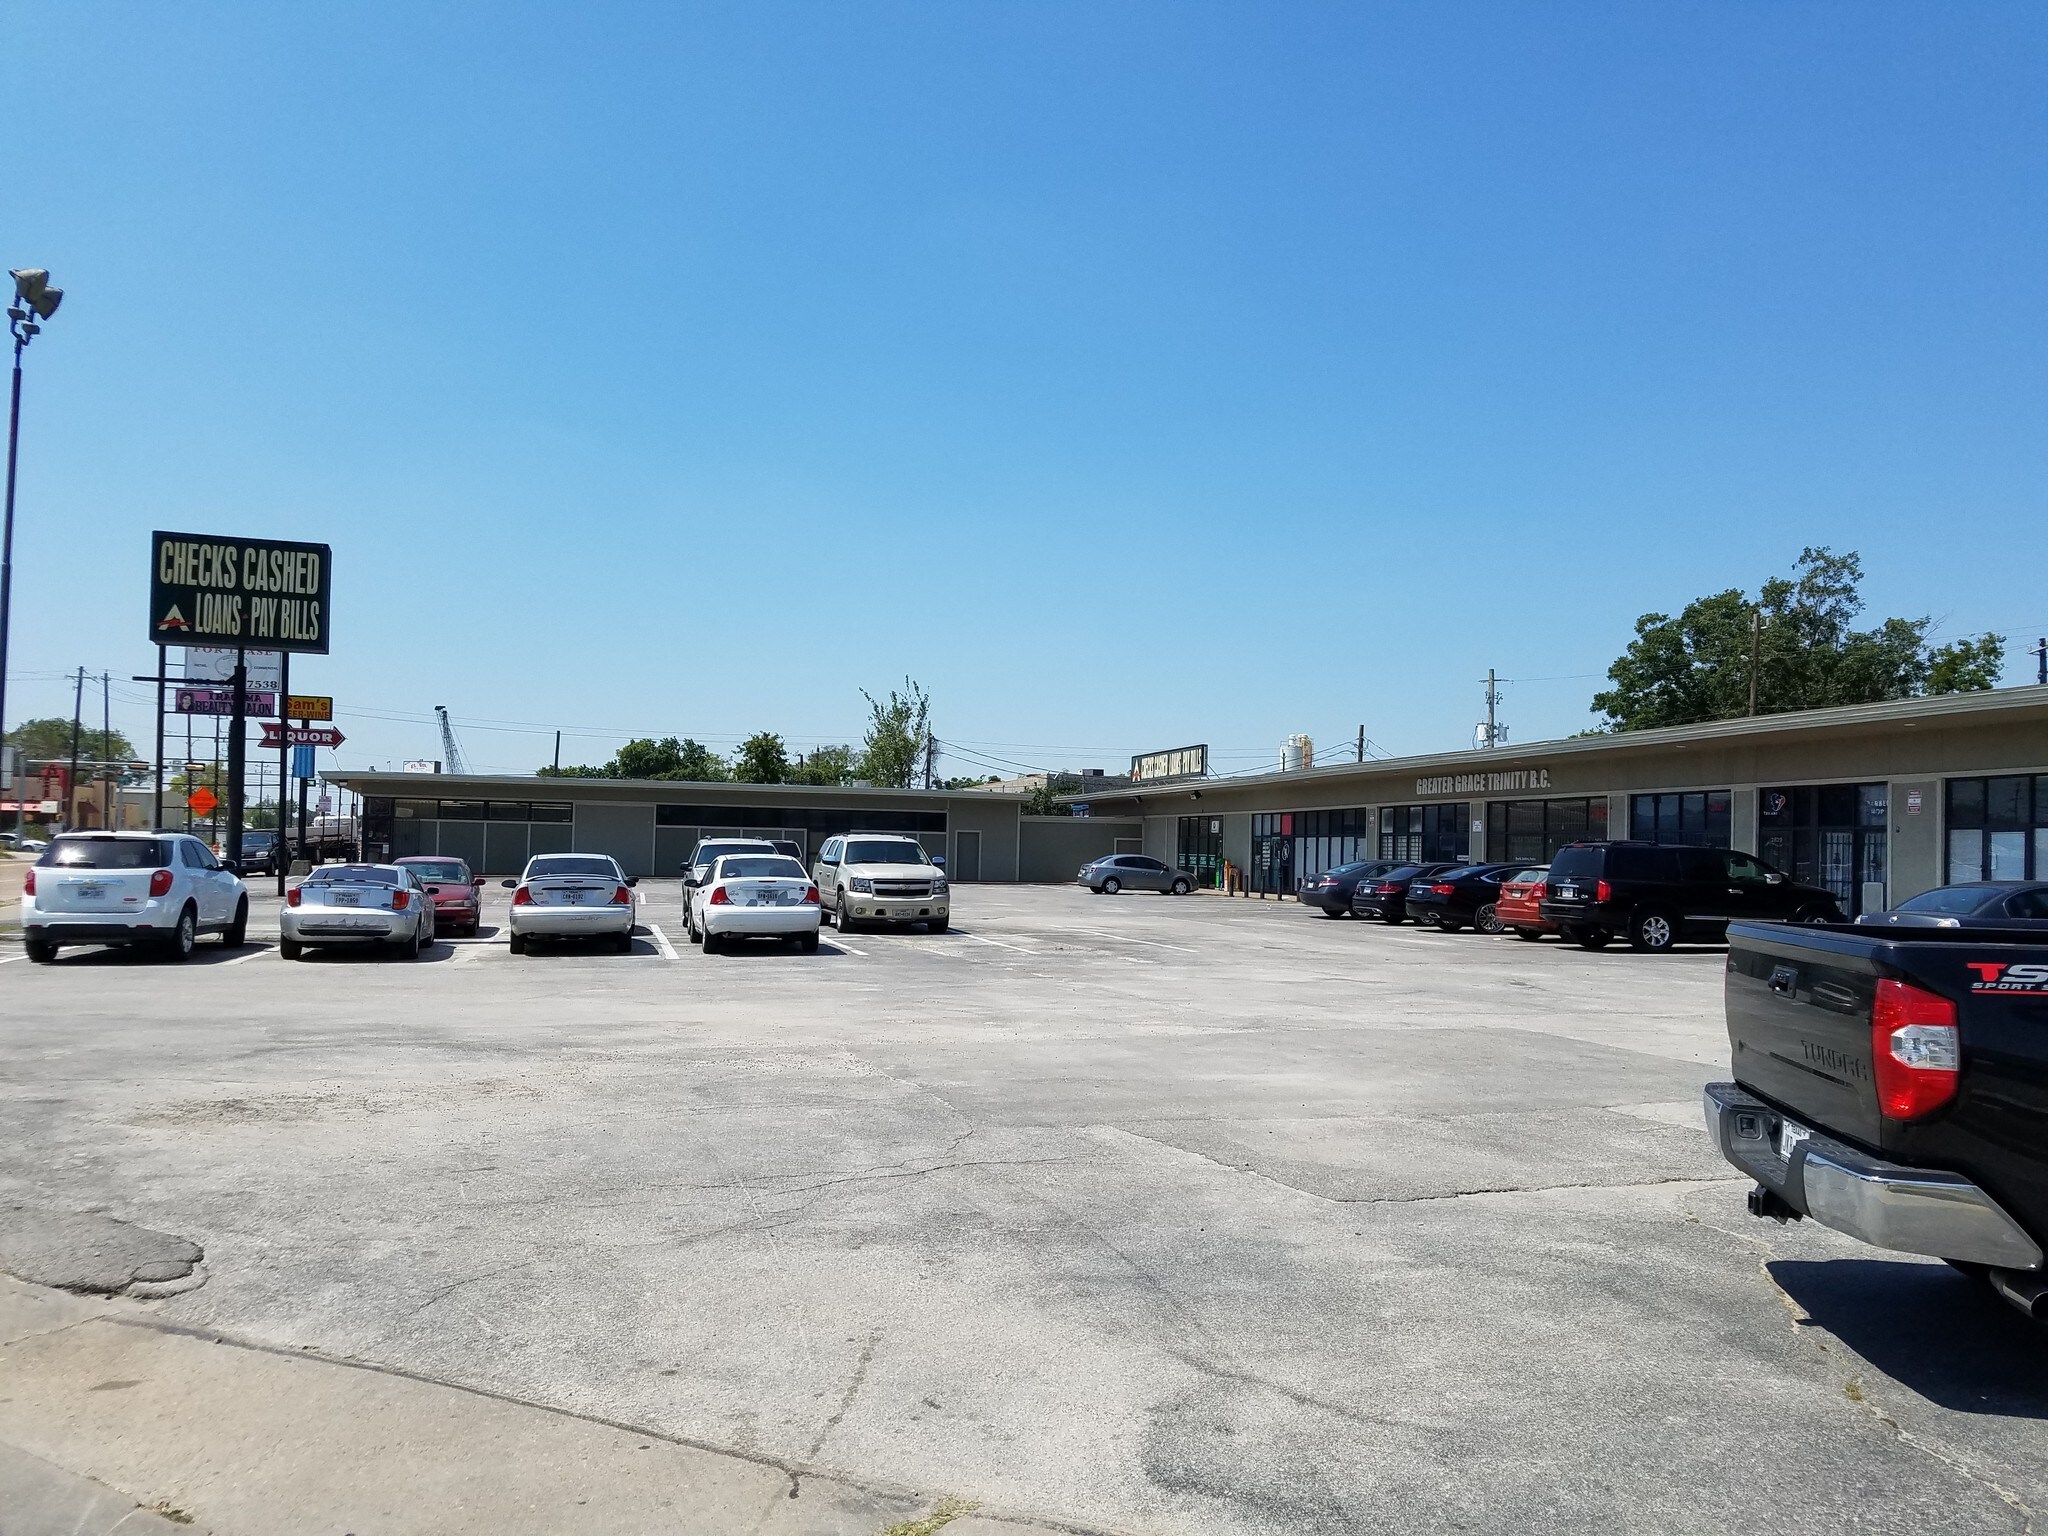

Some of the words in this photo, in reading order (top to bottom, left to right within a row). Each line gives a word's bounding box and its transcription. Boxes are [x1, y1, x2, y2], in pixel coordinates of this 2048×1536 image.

[160, 541, 237, 588] CHECKS
[243, 548, 319, 594] CASHED
[195, 593, 242, 635] LOANS
[250, 597, 278, 637] PAY
[280, 600, 319, 640] BILLS
[246, 703, 272, 715] ALON
[1416, 776, 1454, 795] GREATER
[1455, 774, 1486, 792] GRACE
[1487, 770, 1528, 791] TRINITY
[1530, 769, 1551, 788] B.C.
[1972, 982, 2036, 990] SPORT
[1800, 1039, 1868, 1081] TUNDRA
